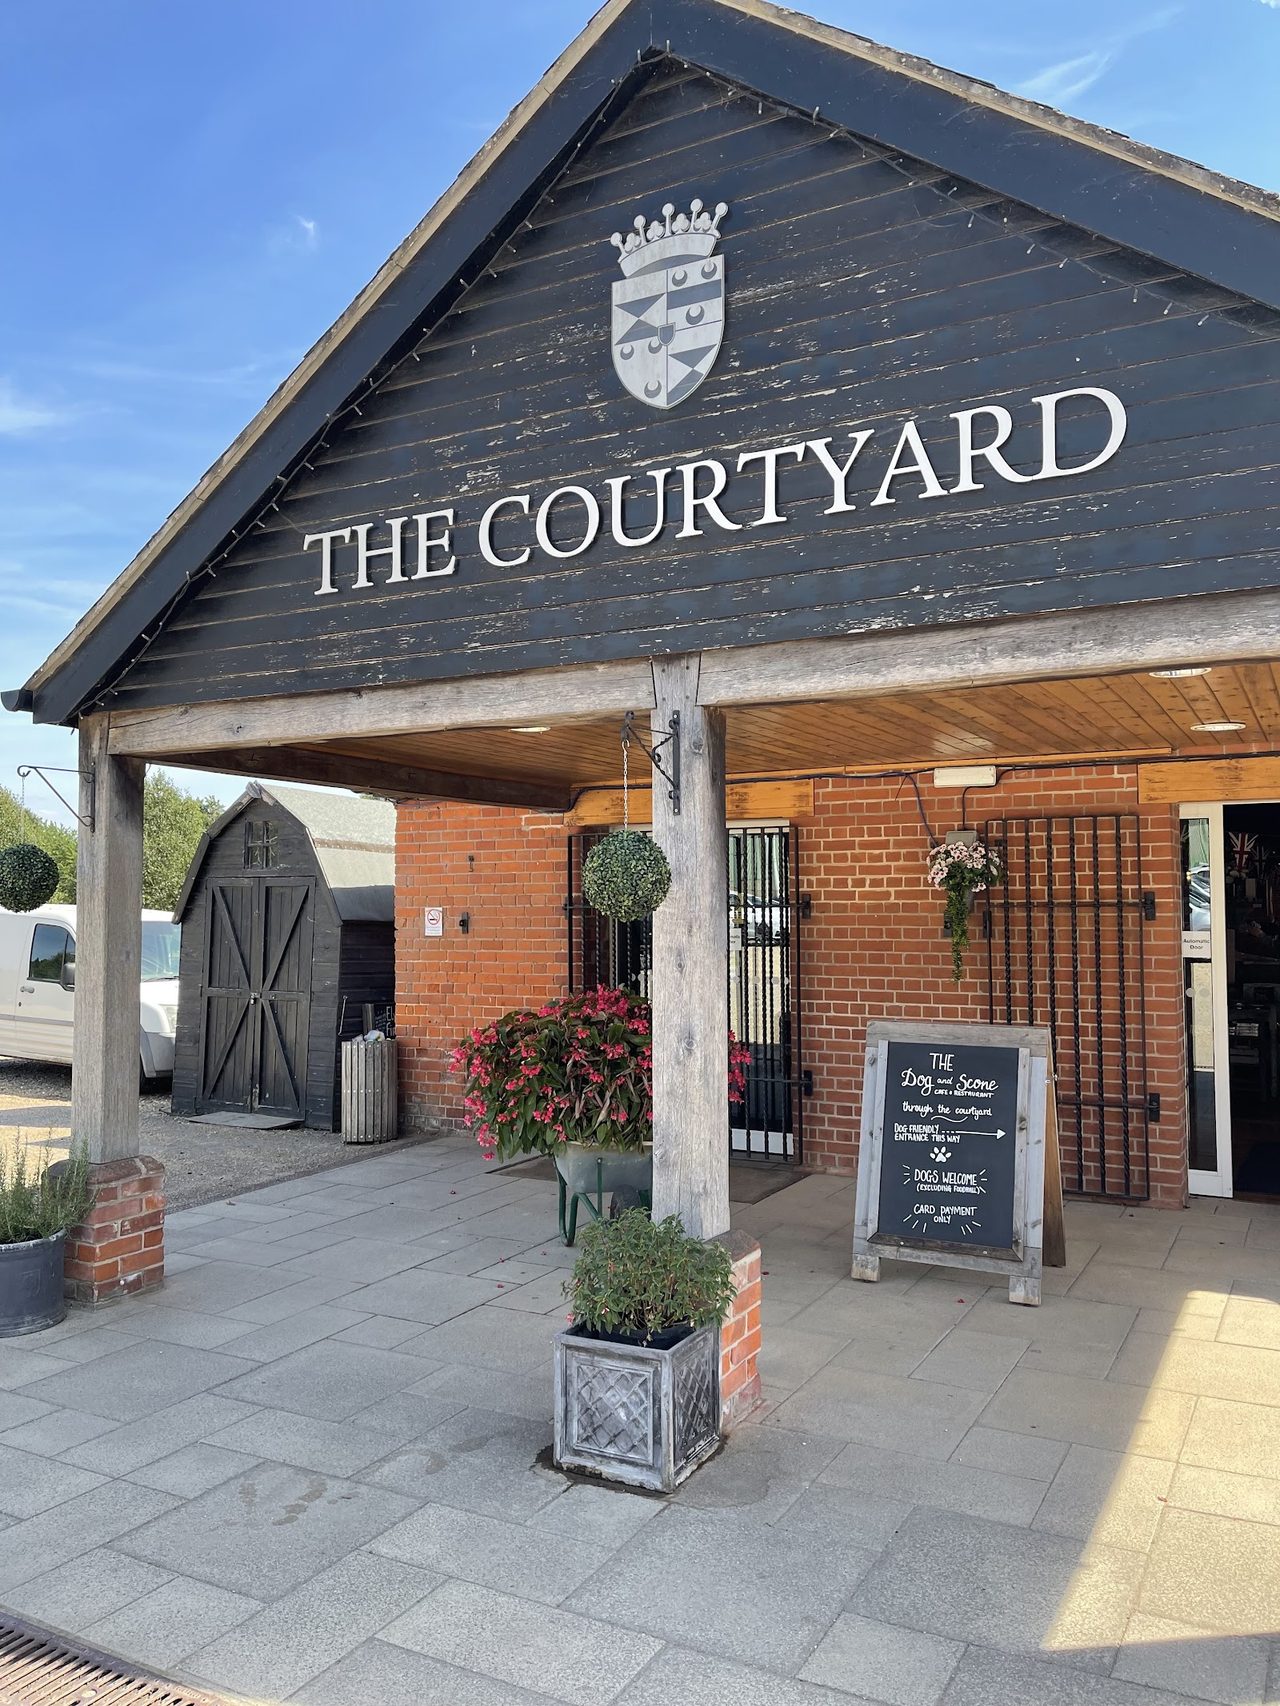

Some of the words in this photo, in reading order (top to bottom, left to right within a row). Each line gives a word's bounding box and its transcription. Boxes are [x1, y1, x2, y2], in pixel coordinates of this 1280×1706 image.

[303, 508, 457, 596] THE
[479, 387, 1127, 568] COURTYARD
[929, 1053, 954, 1071] THE
[901, 1067, 935, 1097] Dog
[936, 1076, 954, 1085] and
[956, 1073, 999, 1091] Scone
[902, 1100, 934, 1118] through
[937, 1103, 952, 1115] the
[955, 1105, 993, 1121] courtyard
[894, 1122, 909, 1134] DOG
[909, 1124, 940, 1135] FRIENDLY
[894, 1132, 930, 1142] ENTRANCE
[931, 1134, 946, 1143] THIS
[946, 1134, 961, 1144] WAY
[914, 1168, 939, 1184] DOGS
[942, 1171, 978, 1186] WELCOME
[913, 1203, 936, 1215] CARD
[940, 1205, 978, 1217] PAYMENT
[933, 1214, 951, 1225] ONLY
